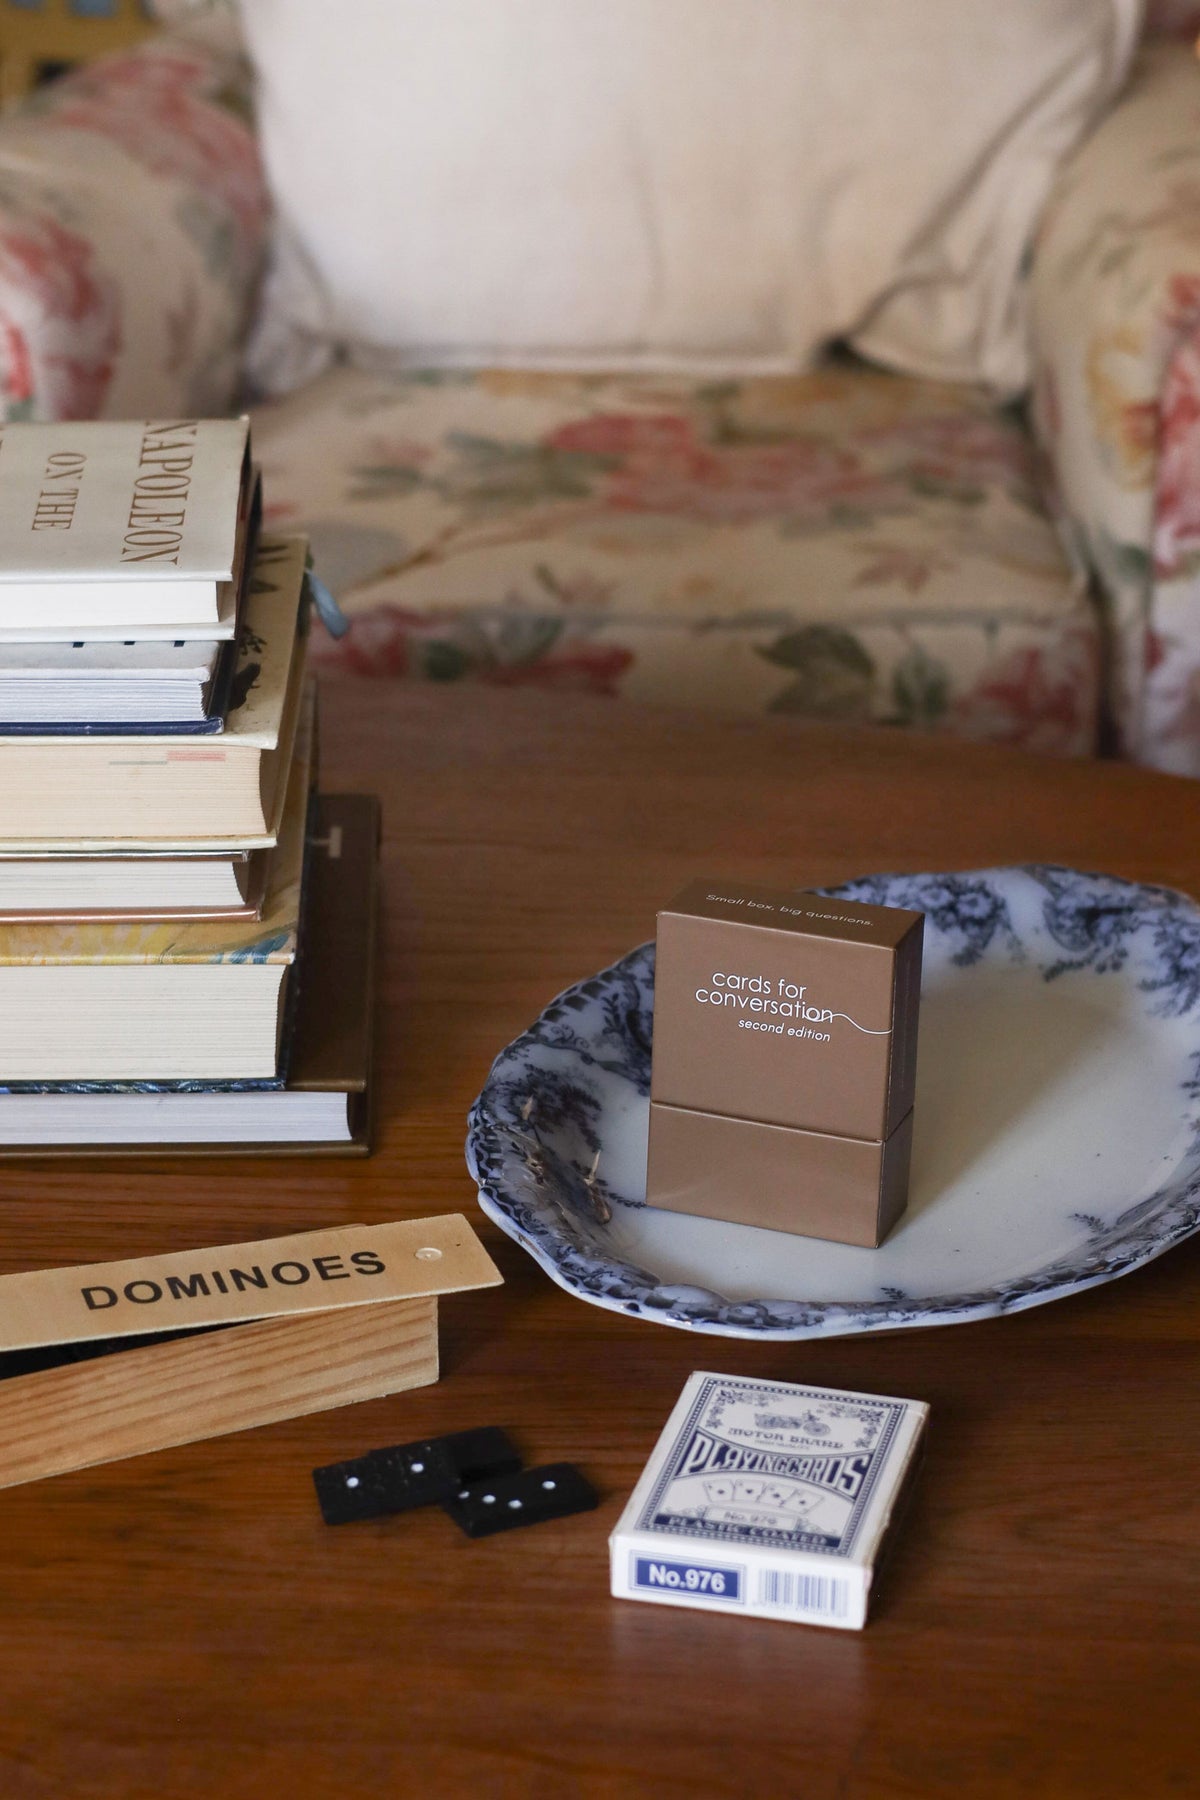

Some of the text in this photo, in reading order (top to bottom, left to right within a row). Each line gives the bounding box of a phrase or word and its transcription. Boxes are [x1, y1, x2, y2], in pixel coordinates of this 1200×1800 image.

[31, 451, 87, 531] ON THE
[120, 420, 198, 565] NAPOLEON
[706, 894, 874, 925] Small box, big questions.
[712, 972, 807, 999] cards for
[695, 988, 833, 1024] conversation
[738, 1018, 831, 1042] second edition
[81, 1251, 386, 1310] DOMINOES
[728, 1427, 784, 1441] MOTOR
[669, 1517, 828, 1545] PLASTIC COATED
[649, 1563, 726, 1594] No.976
